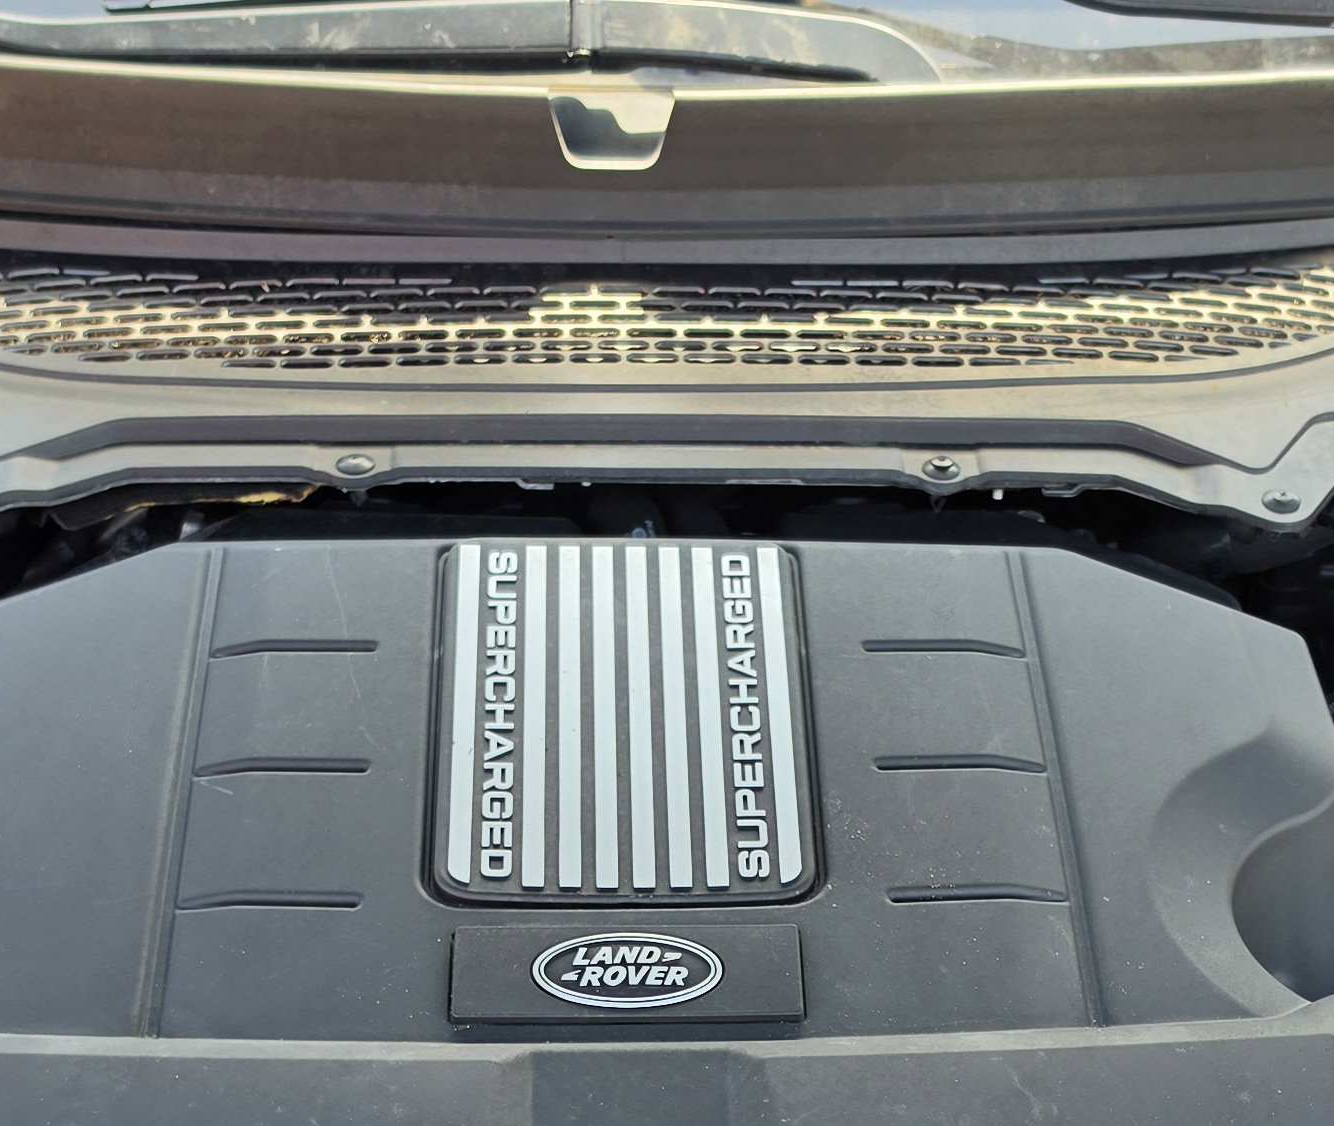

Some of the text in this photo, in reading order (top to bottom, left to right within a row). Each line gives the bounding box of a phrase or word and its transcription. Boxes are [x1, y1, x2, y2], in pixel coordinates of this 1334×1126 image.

[480, 551, 518, 878] SUPERCHARGED
[720, 553, 770, 878] SUPERCHARGED
[572, 946, 662, 966] LAND
[579, 965, 689, 987] ROVER
